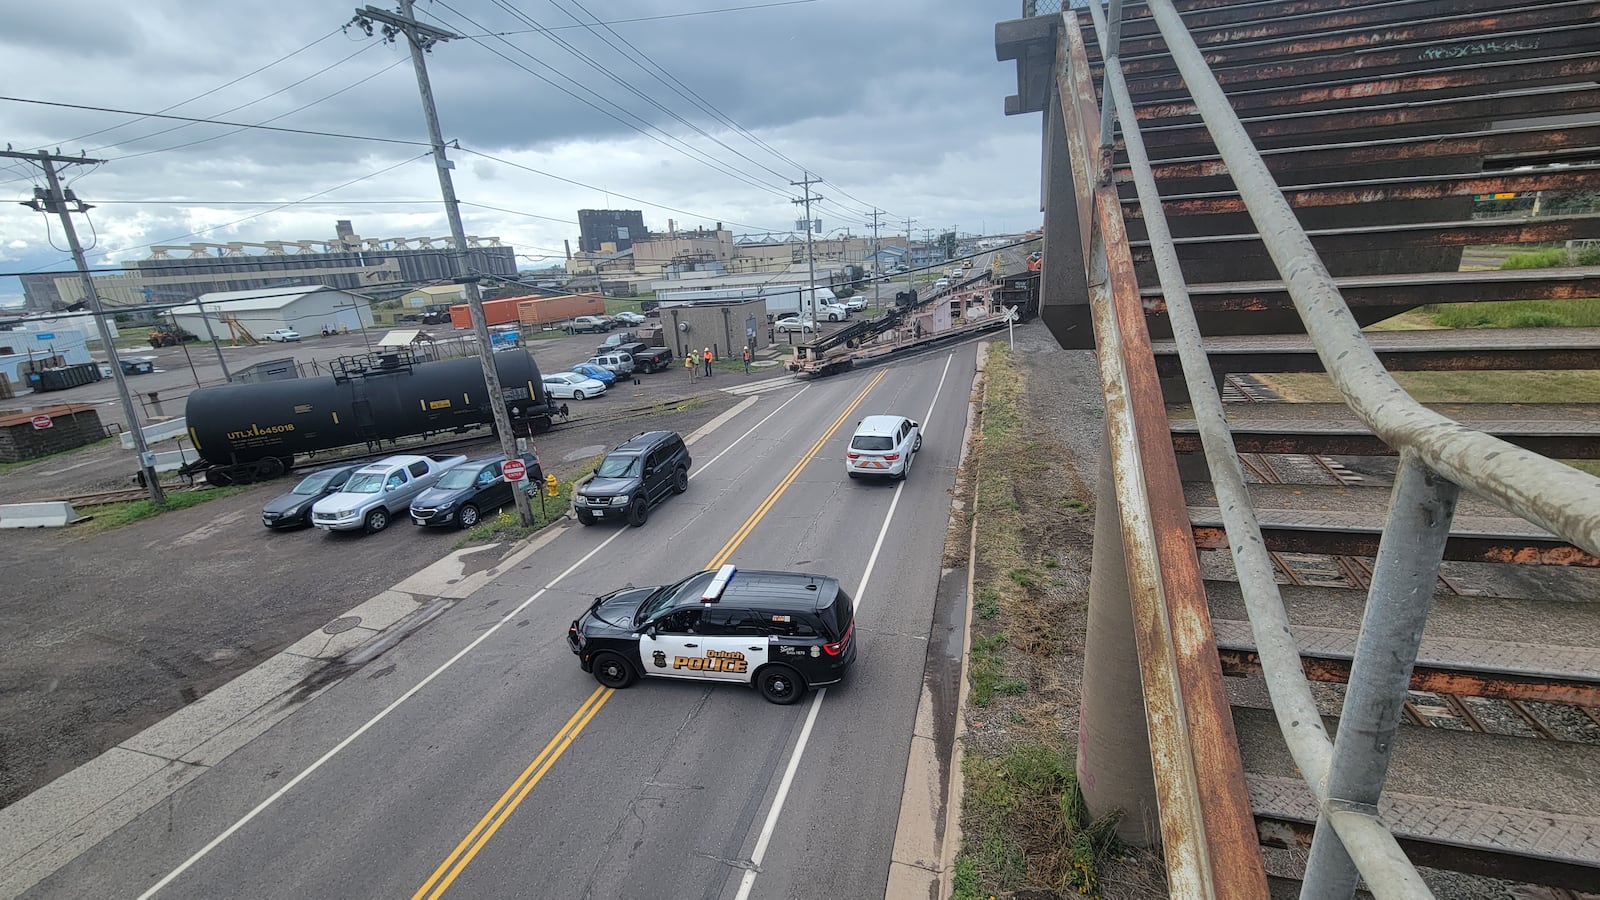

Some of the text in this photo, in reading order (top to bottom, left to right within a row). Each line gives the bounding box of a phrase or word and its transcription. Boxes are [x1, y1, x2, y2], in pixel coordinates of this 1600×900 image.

[227, 430, 254, 440] UTLX
[259, 423, 295, 436] 645018
[706, 650, 745, 660] Duluth
[673, 656, 748, 673] POLICE
